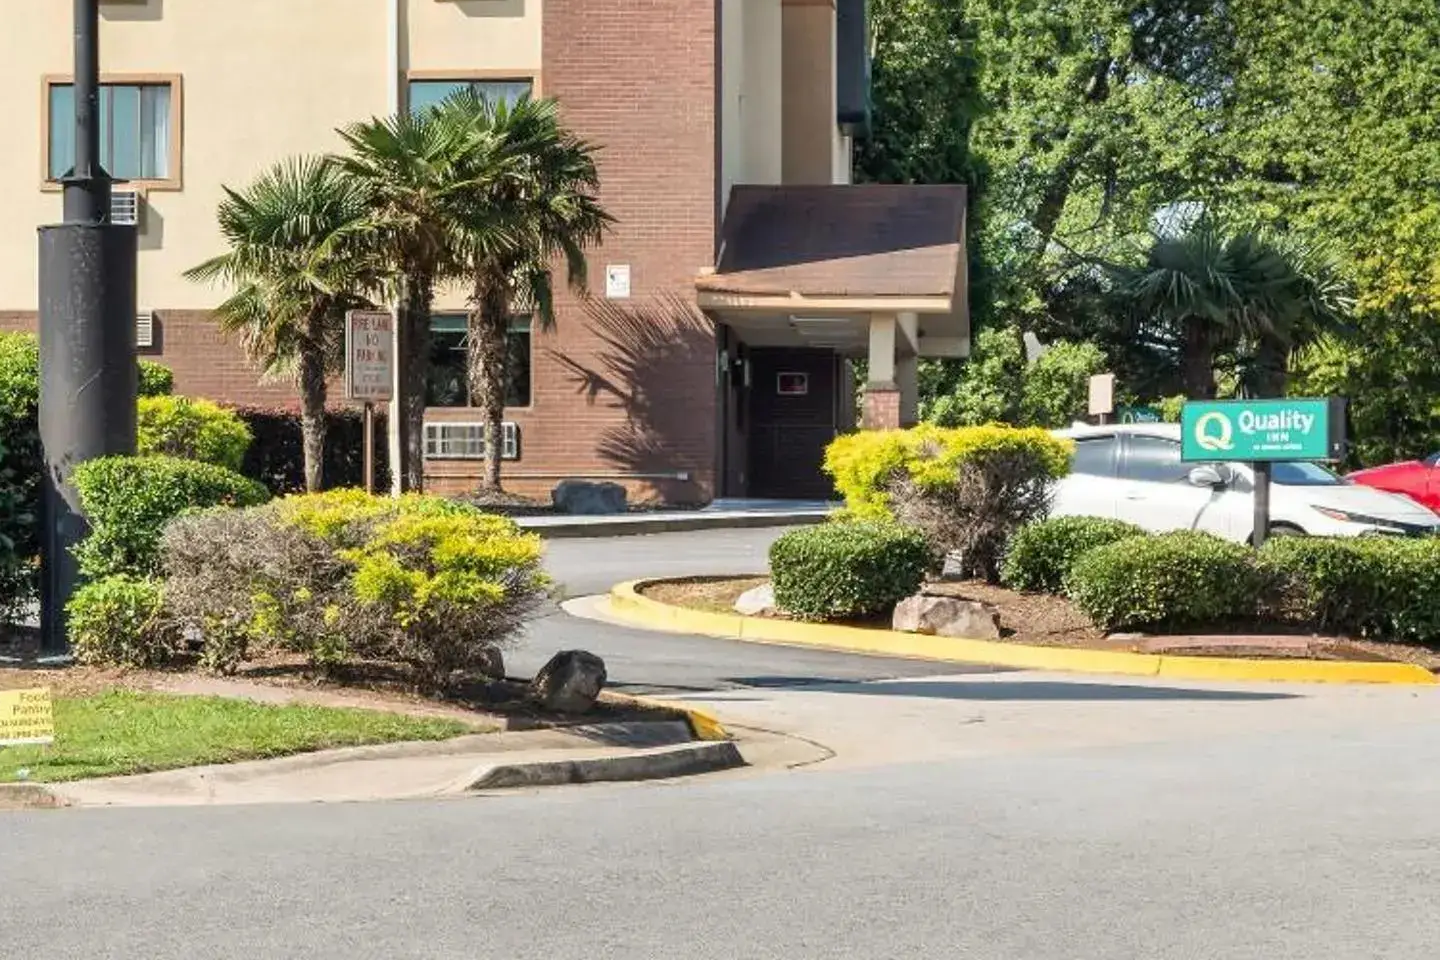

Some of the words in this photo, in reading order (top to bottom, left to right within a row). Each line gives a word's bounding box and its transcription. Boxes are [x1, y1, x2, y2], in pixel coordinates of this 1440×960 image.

[1238, 409, 1315, 435] Quality
[1195, 411, 1236, 451] Q
[1266, 431, 1290, 442] INN
[20, 692, 49, 702] Food
[12, 704, 52, 716] Pantry
